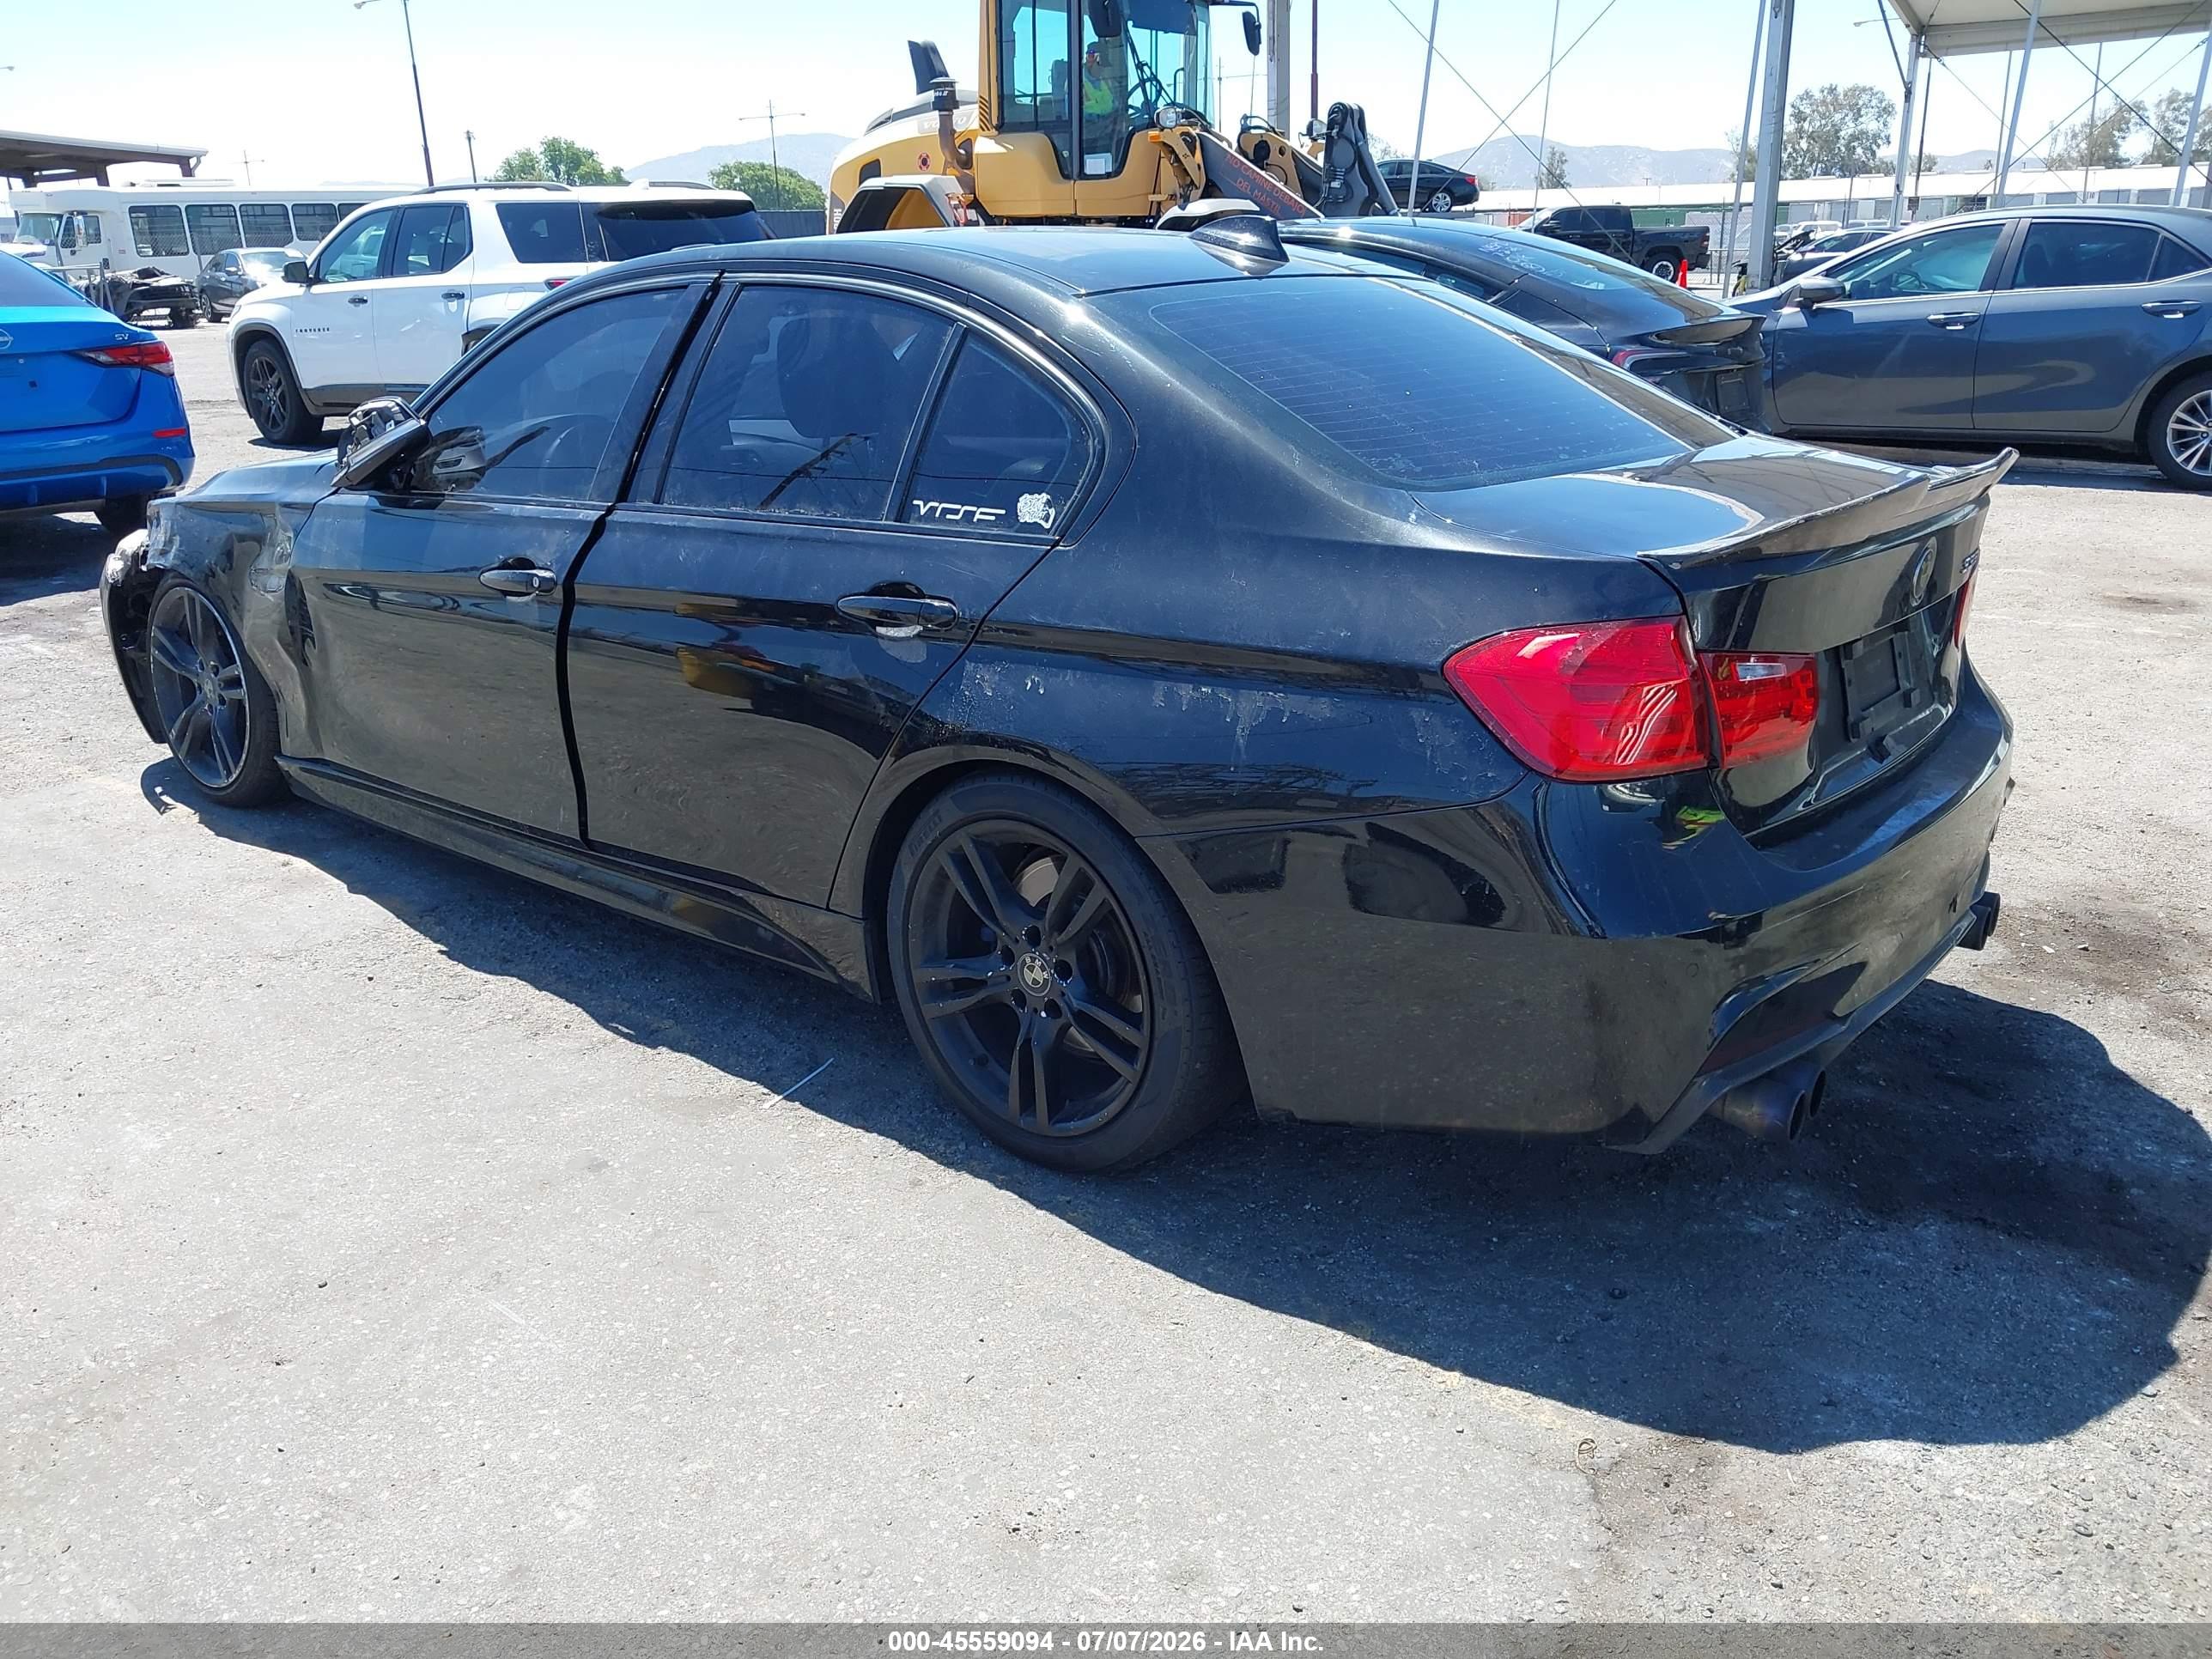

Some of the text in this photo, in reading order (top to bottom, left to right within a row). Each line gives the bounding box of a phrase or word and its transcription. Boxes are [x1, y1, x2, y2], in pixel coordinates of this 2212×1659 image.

[1237, 178, 1252, 195] DEL
[1241, 163, 1272, 191] CAMINE
[1025, 956, 1049, 980] BMW
